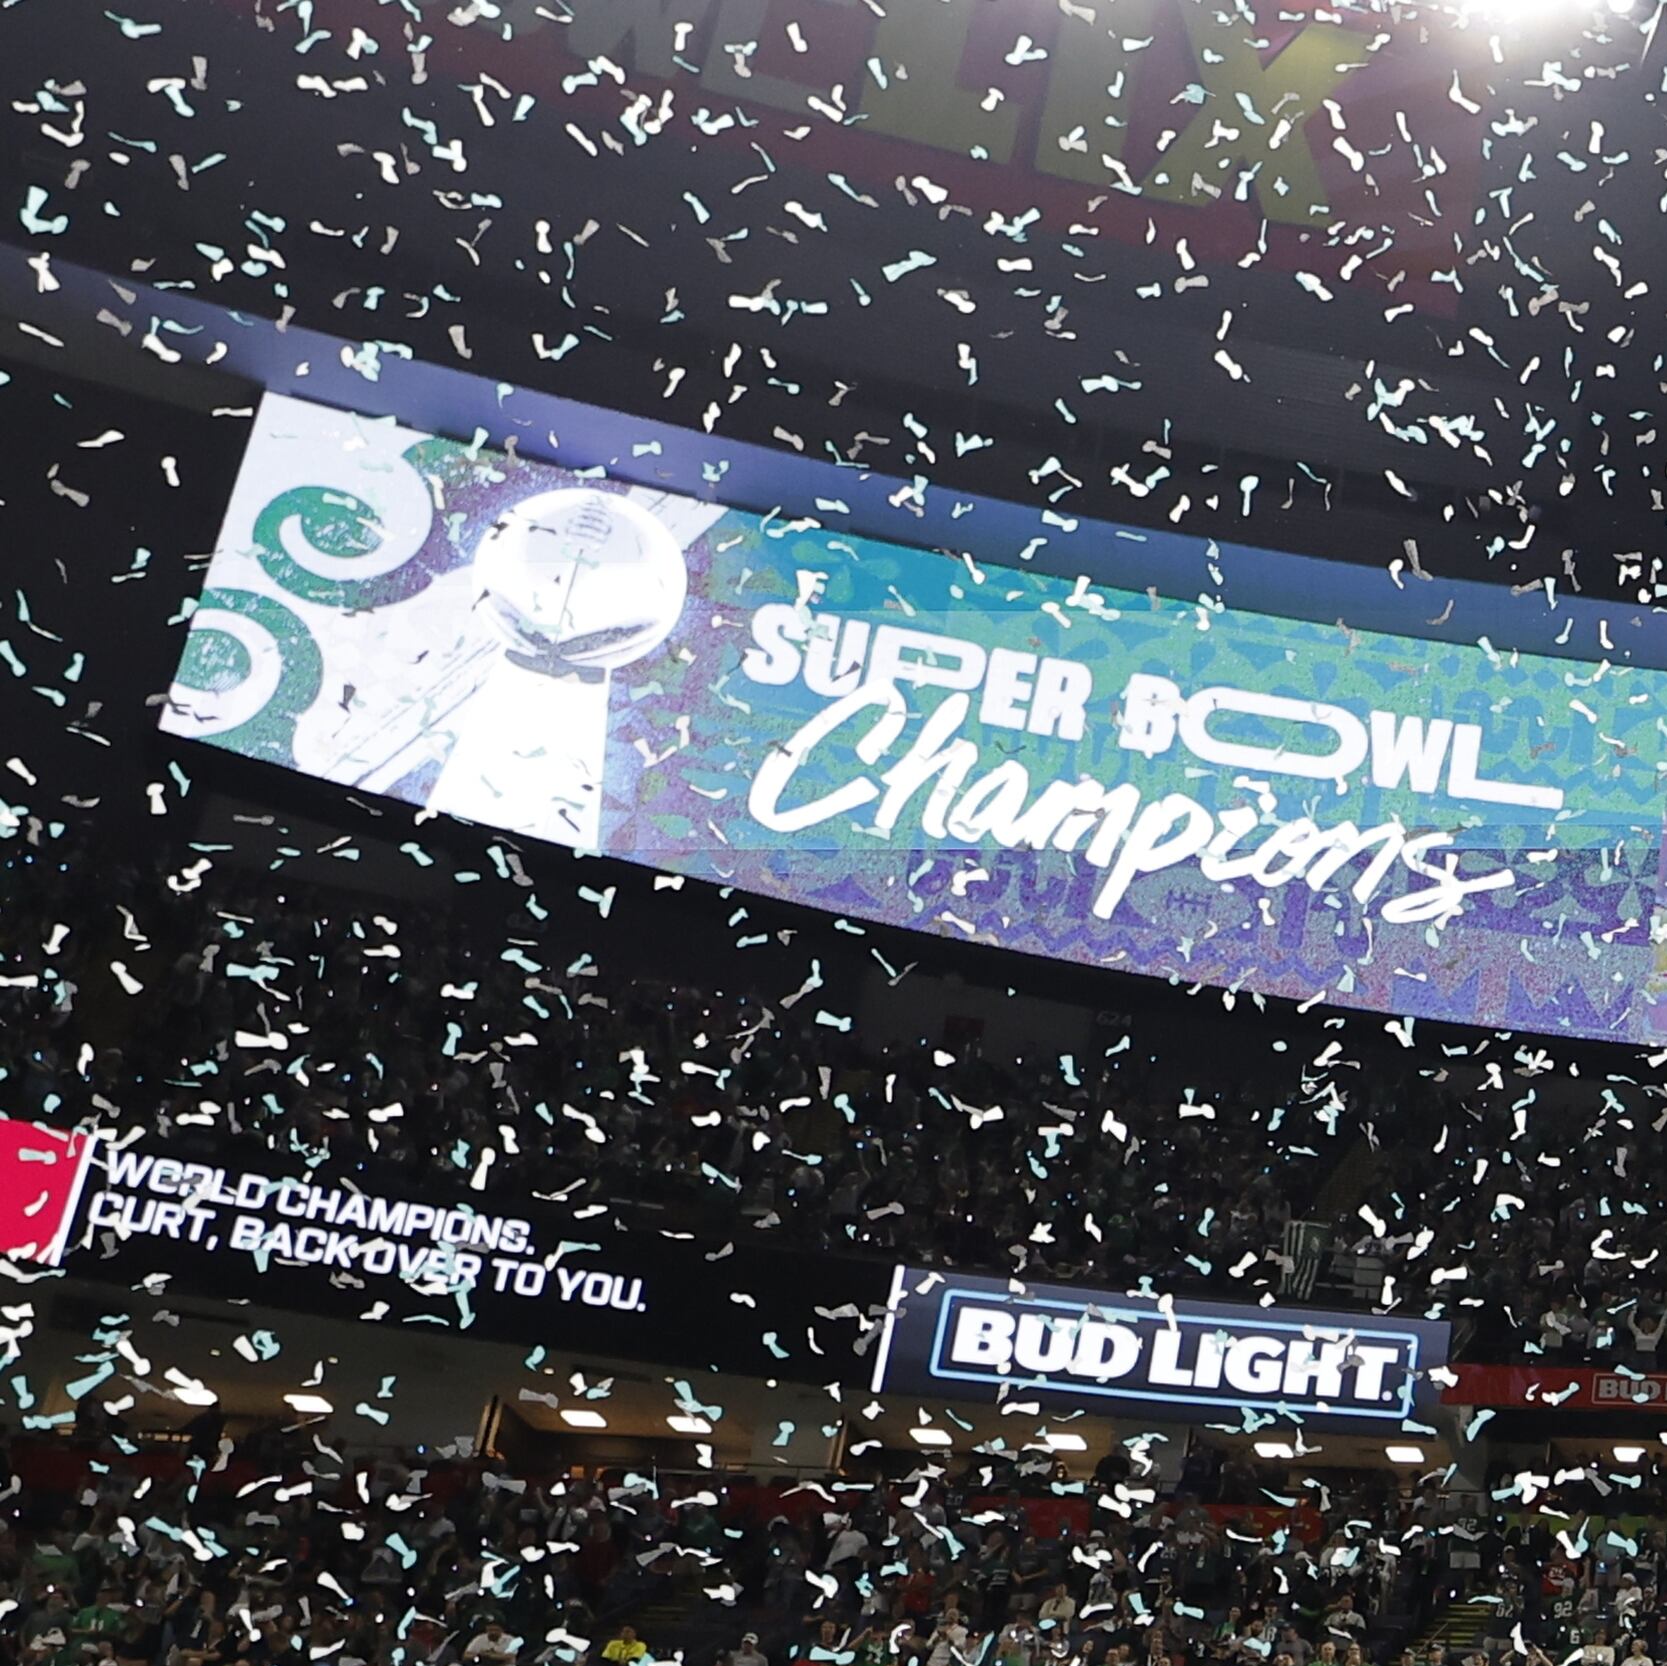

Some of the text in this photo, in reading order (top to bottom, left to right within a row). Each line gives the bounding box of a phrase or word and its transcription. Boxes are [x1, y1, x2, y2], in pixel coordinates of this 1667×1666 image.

[741, 602, 1564, 811] SUPER BOWL
[746, 679, 1517, 929] Champions
[88, 1191, 224, 1251] CURT,
[231, 1216, 360, 1268] BACK
[491, 1258, 546, 1299] TO
[556, 1268, 649, 1314] YOU.
[106, 1150, 537, 1257] WORLD CHAMPIONS.
[952, 1306, 1140, 1380] BUD
[1598, 1377, 1662, 1404] BUD
